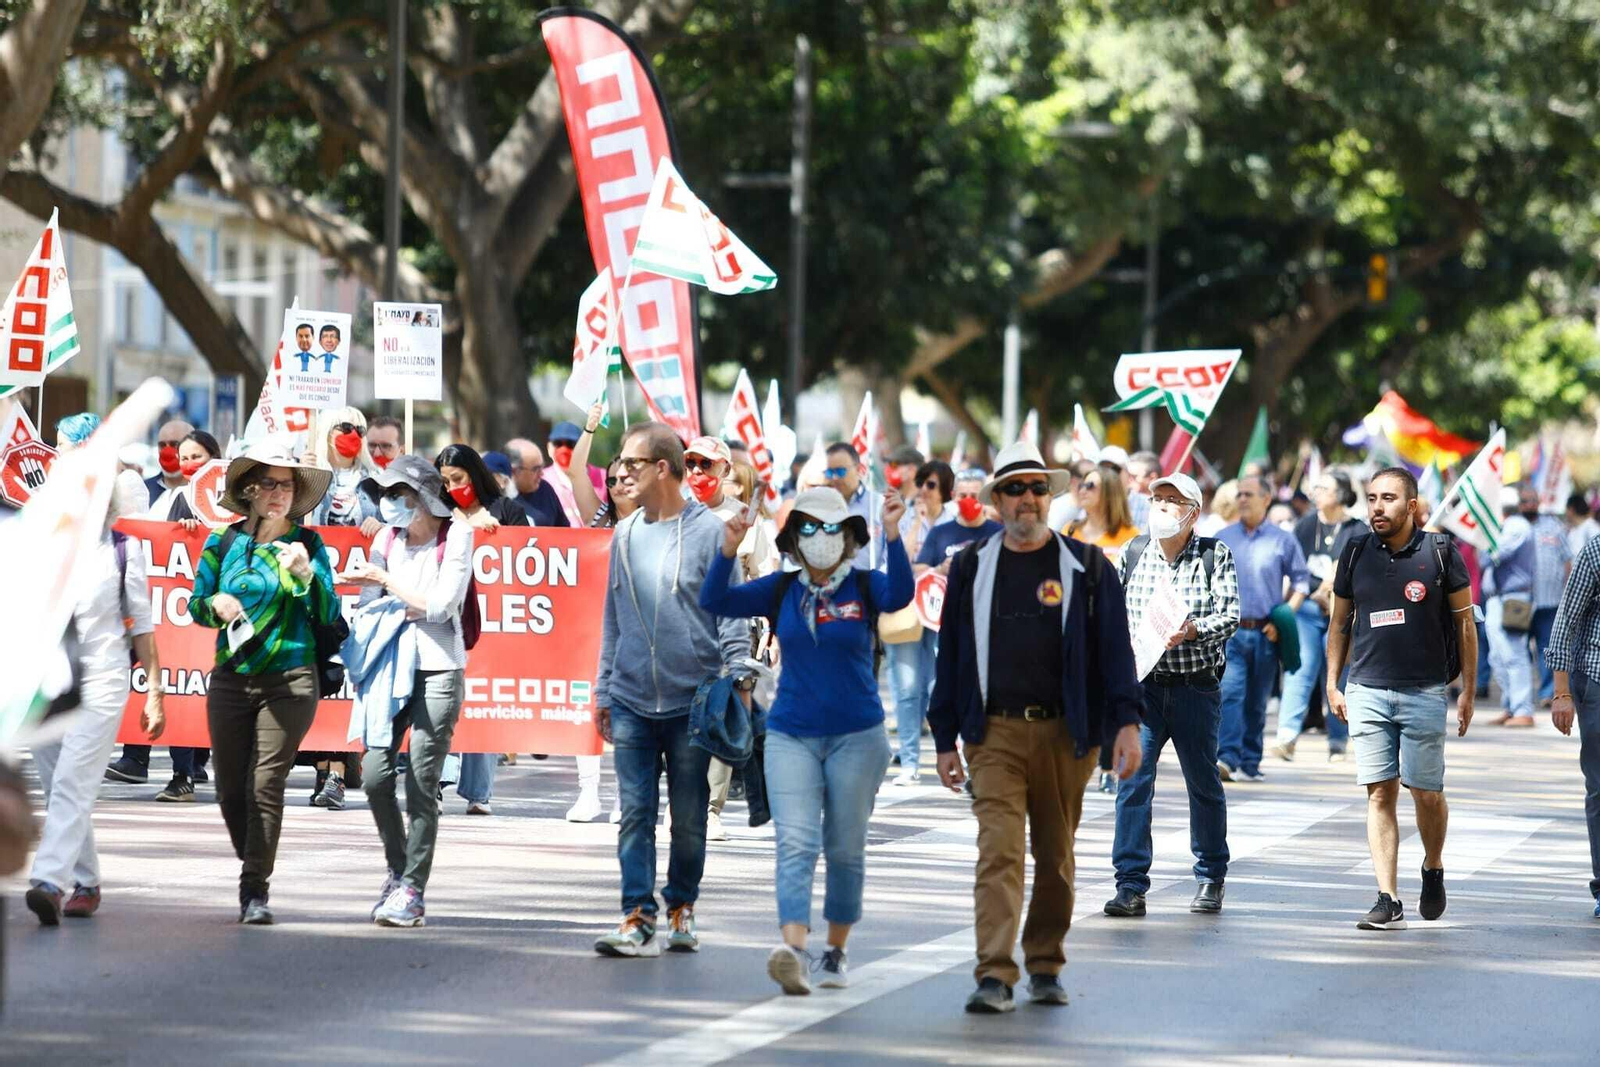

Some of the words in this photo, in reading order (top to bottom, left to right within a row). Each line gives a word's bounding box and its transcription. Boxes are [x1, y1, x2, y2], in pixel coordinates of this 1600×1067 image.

[391, 310, 411, 318] MAYO
[383, 337, 398, 352] NO
[24, 468, 46, 489] NO
[464, 677, 567, 703] CCOO
[464, 704, 534, 720] servicios
[540, 705, 592, 725] málaga
